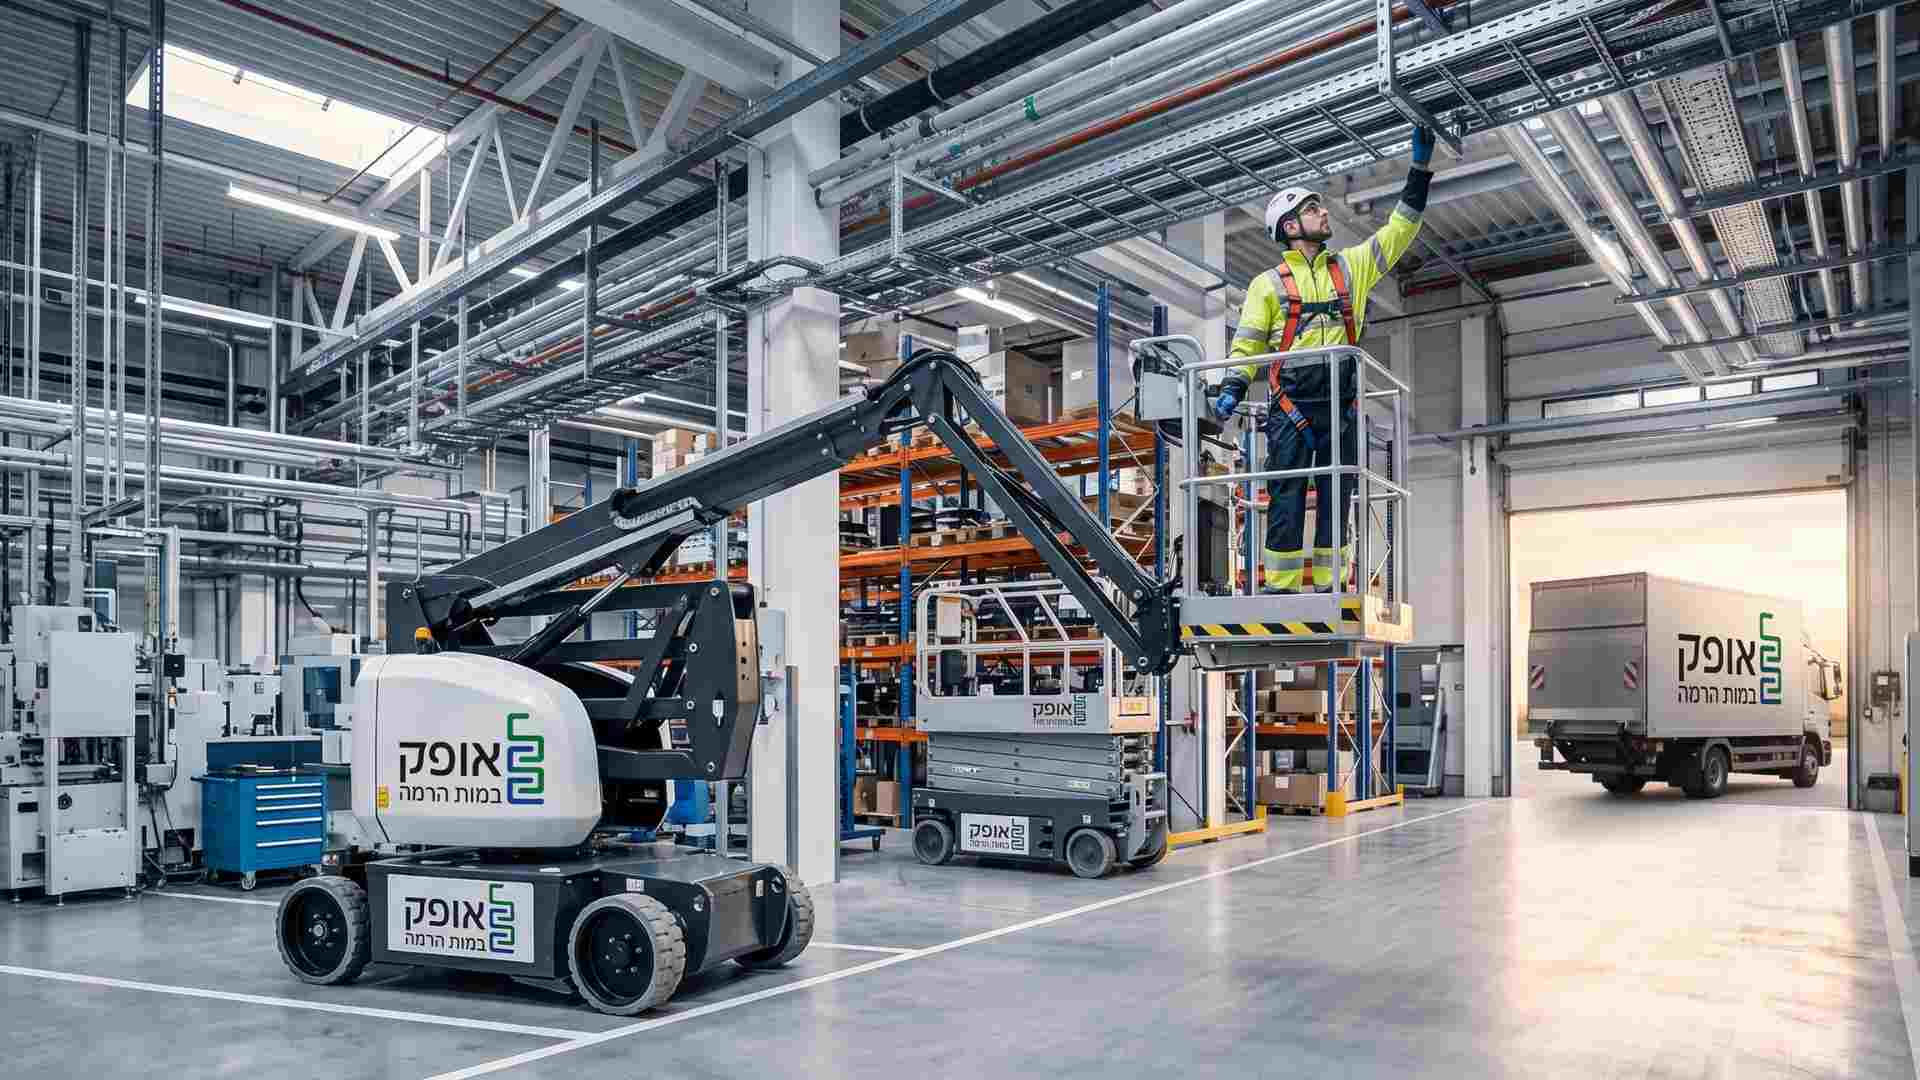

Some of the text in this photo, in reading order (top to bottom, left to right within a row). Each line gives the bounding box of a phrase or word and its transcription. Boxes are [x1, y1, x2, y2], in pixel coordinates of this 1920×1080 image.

[1678, 634, 1756, 681] אופק
[1677, 686, 1757, 704] במות הרמה
[1033, 703, 1072, 718] אופק
[400, 742, 502, 783] אופק
[399, 785, 502, 804] במות הרמה
[969, 824, 1009, 839] אופק
[404, 897, 486, 931] אופק
[405, 932, 487, 953] במות הרמה
